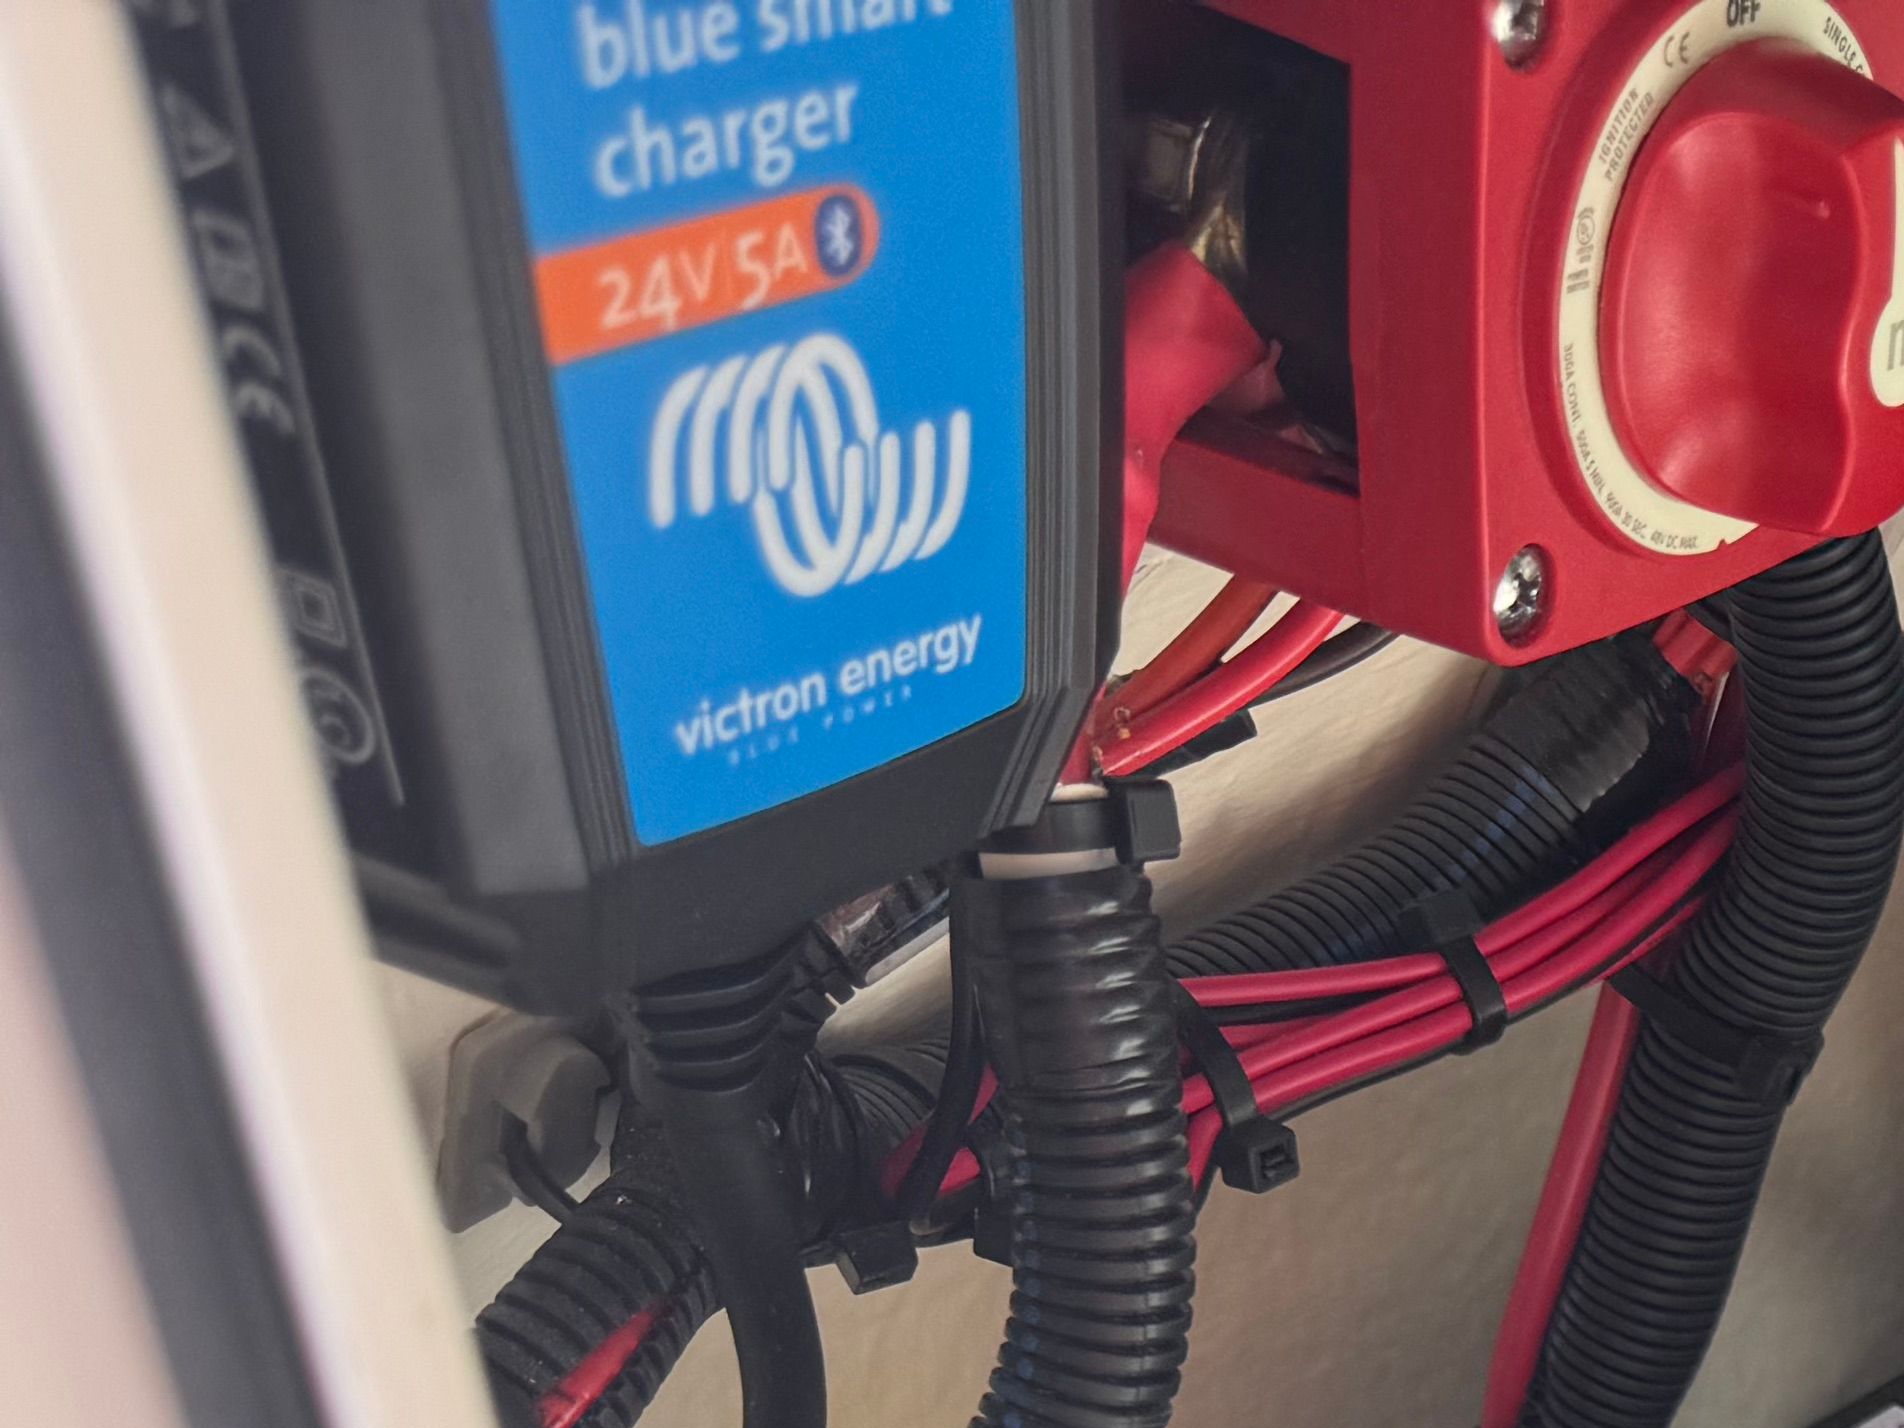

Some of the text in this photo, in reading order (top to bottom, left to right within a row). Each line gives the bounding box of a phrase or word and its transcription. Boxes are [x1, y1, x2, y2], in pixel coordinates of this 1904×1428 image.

[576, 0, 740, 89] blue
[595, 84, 858, 196] charger
[1600, 87, 1638, 164] IGNITION
[1604, 92, 1655, 182] PROTECTED
[600, 222, 808, 331] 24V 5A
[674, 613, 982, 756] victron energy
